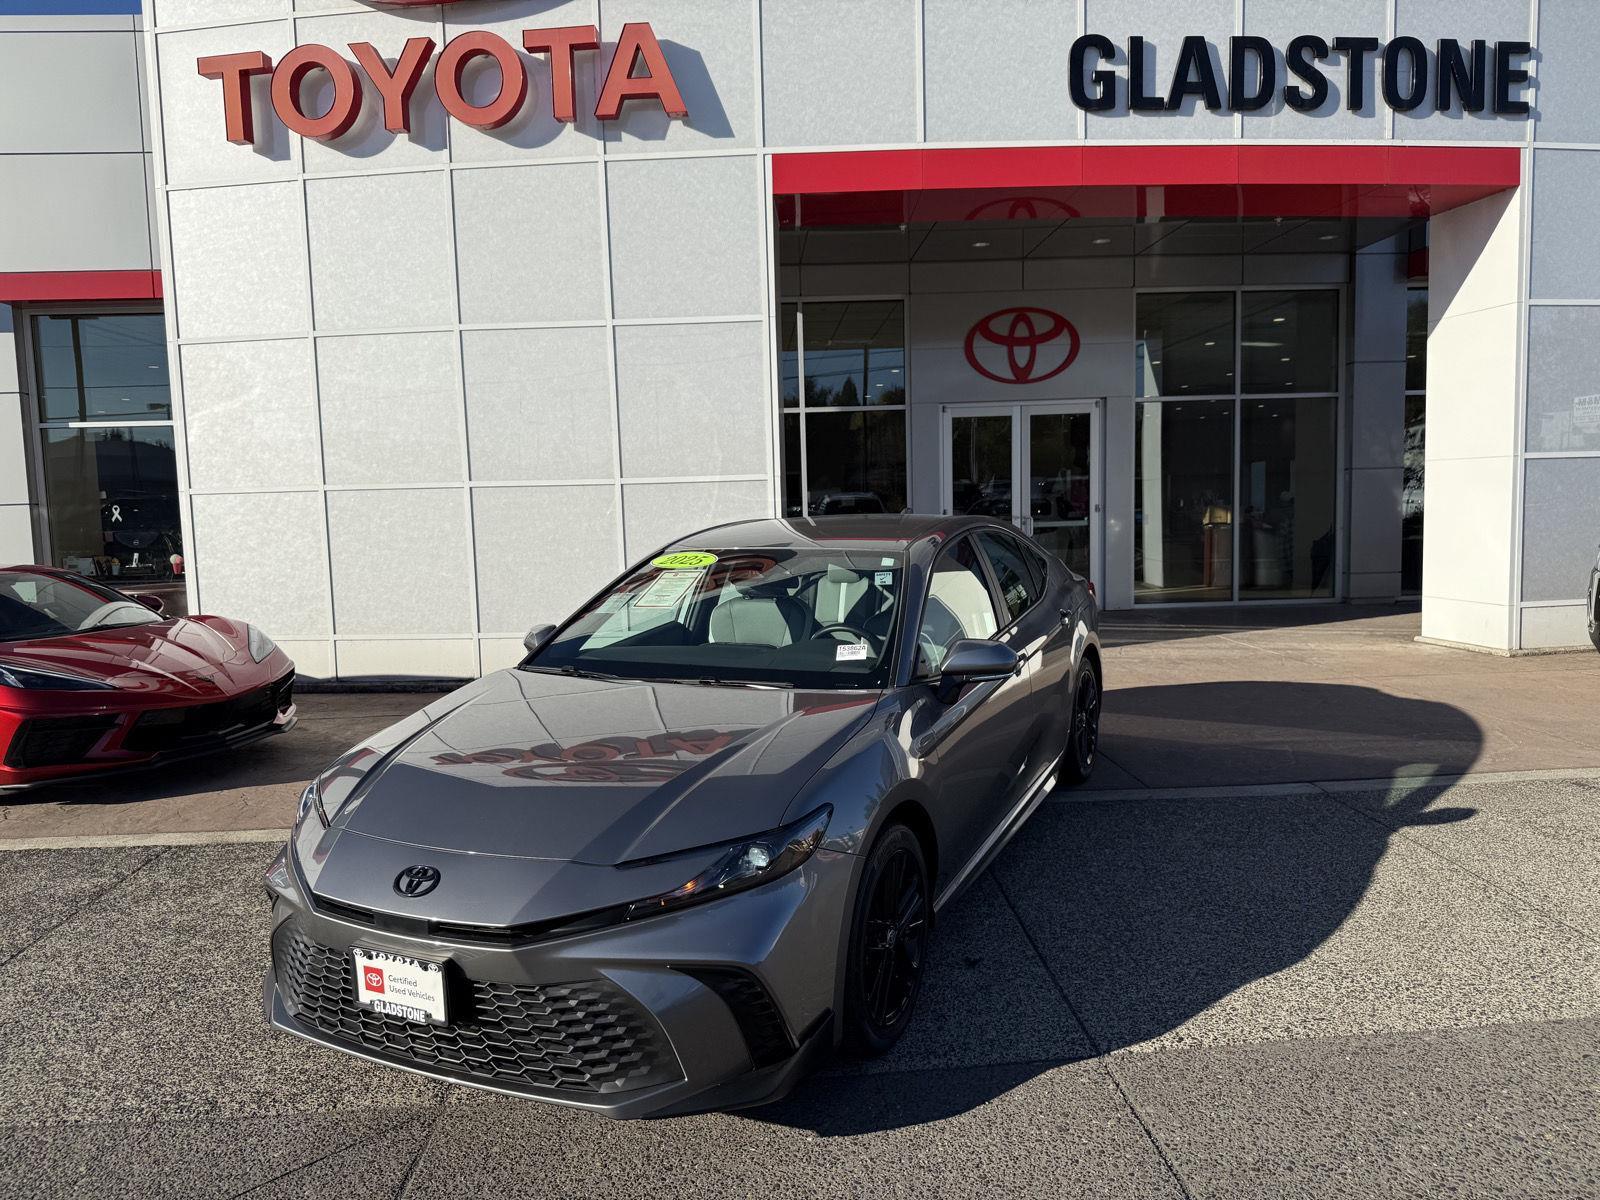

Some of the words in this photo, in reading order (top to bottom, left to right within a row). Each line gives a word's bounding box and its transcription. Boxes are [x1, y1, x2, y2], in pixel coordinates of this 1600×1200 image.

[1069, 34, 1532, 114] GLADSTONE
[197, 22, 688, 145] TOYOTA
[659, 555, 710, 566] 2025
[371, 951, 420, 968] TOYOTA
[388, 974, 418, 987] Certified
[389, 985, 407, 995] Used
[407, 988, 435, 1002] Vehicles
[374, 1001, 426, 1023] GLADSTONE
